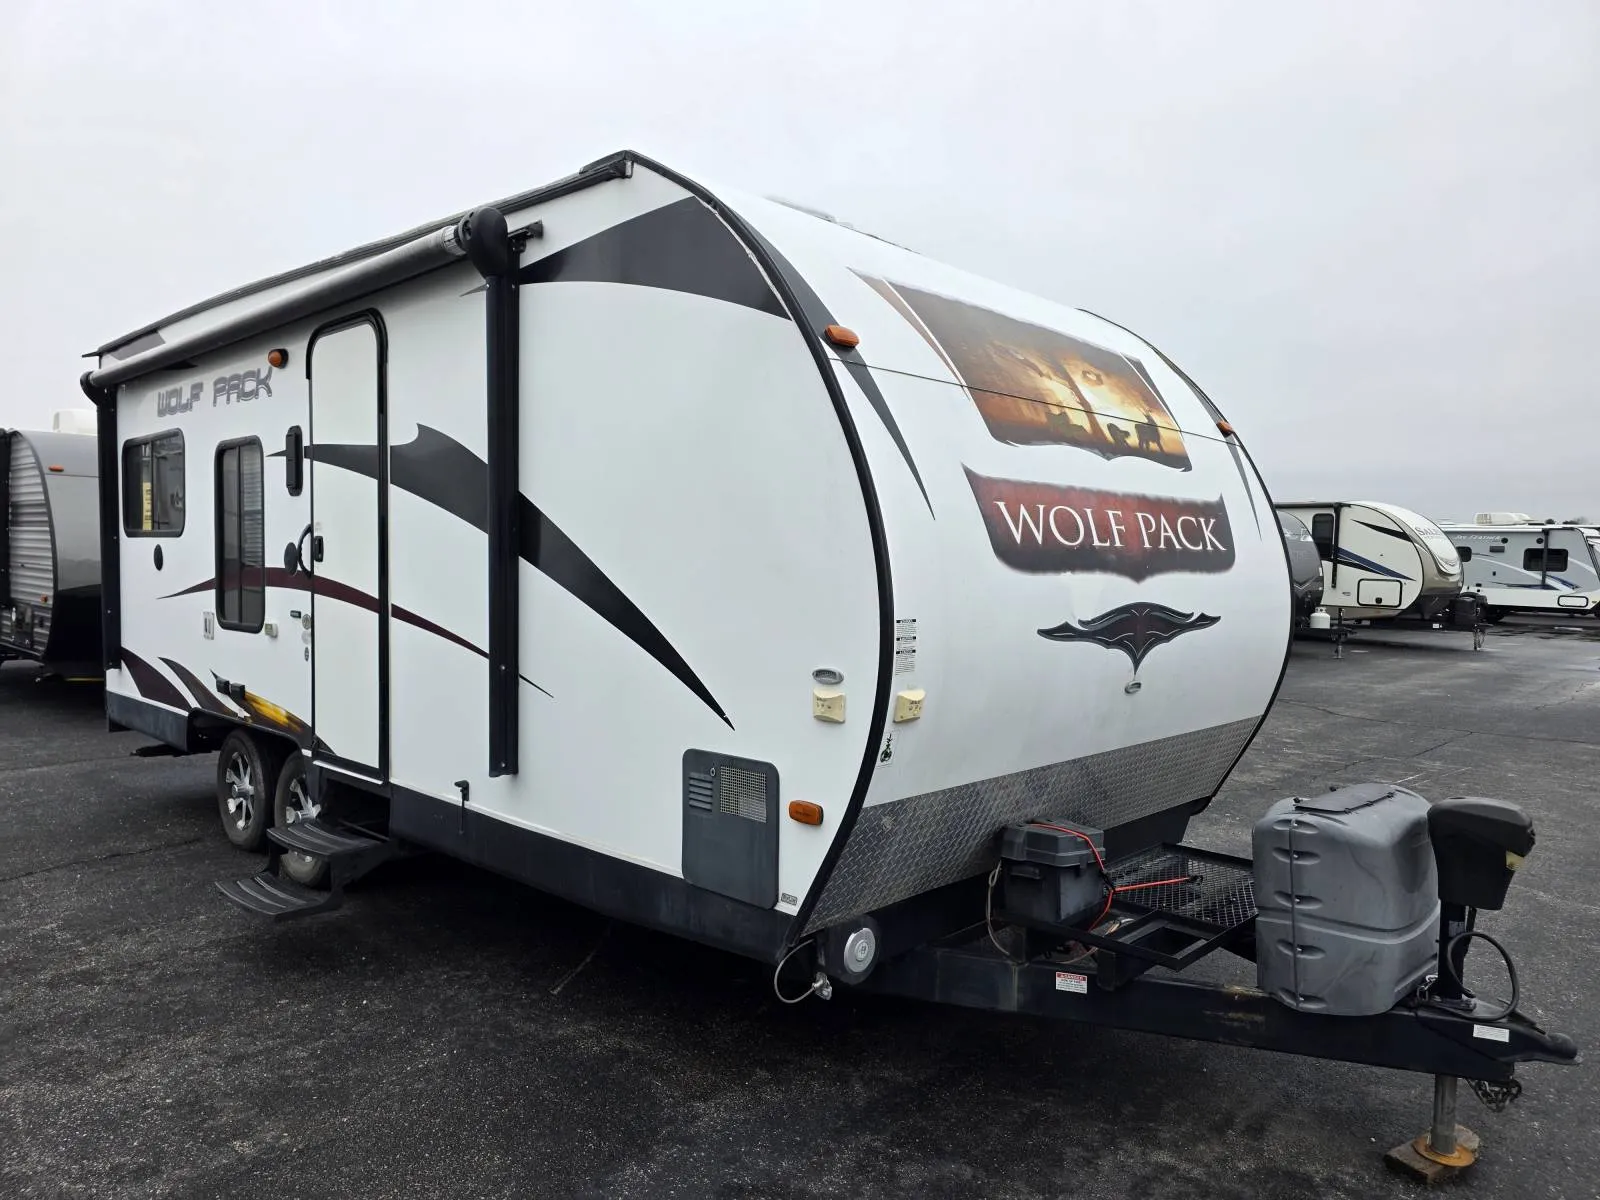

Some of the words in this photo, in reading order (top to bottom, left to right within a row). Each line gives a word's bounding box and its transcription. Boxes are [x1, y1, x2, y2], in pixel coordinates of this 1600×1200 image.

[157, 382, 203, 417] WOLF
[213, 366, 273, 407] PACK
[994, 501, 1126, 547] WOLF
[1135, 512, 1227, 550] PACK
